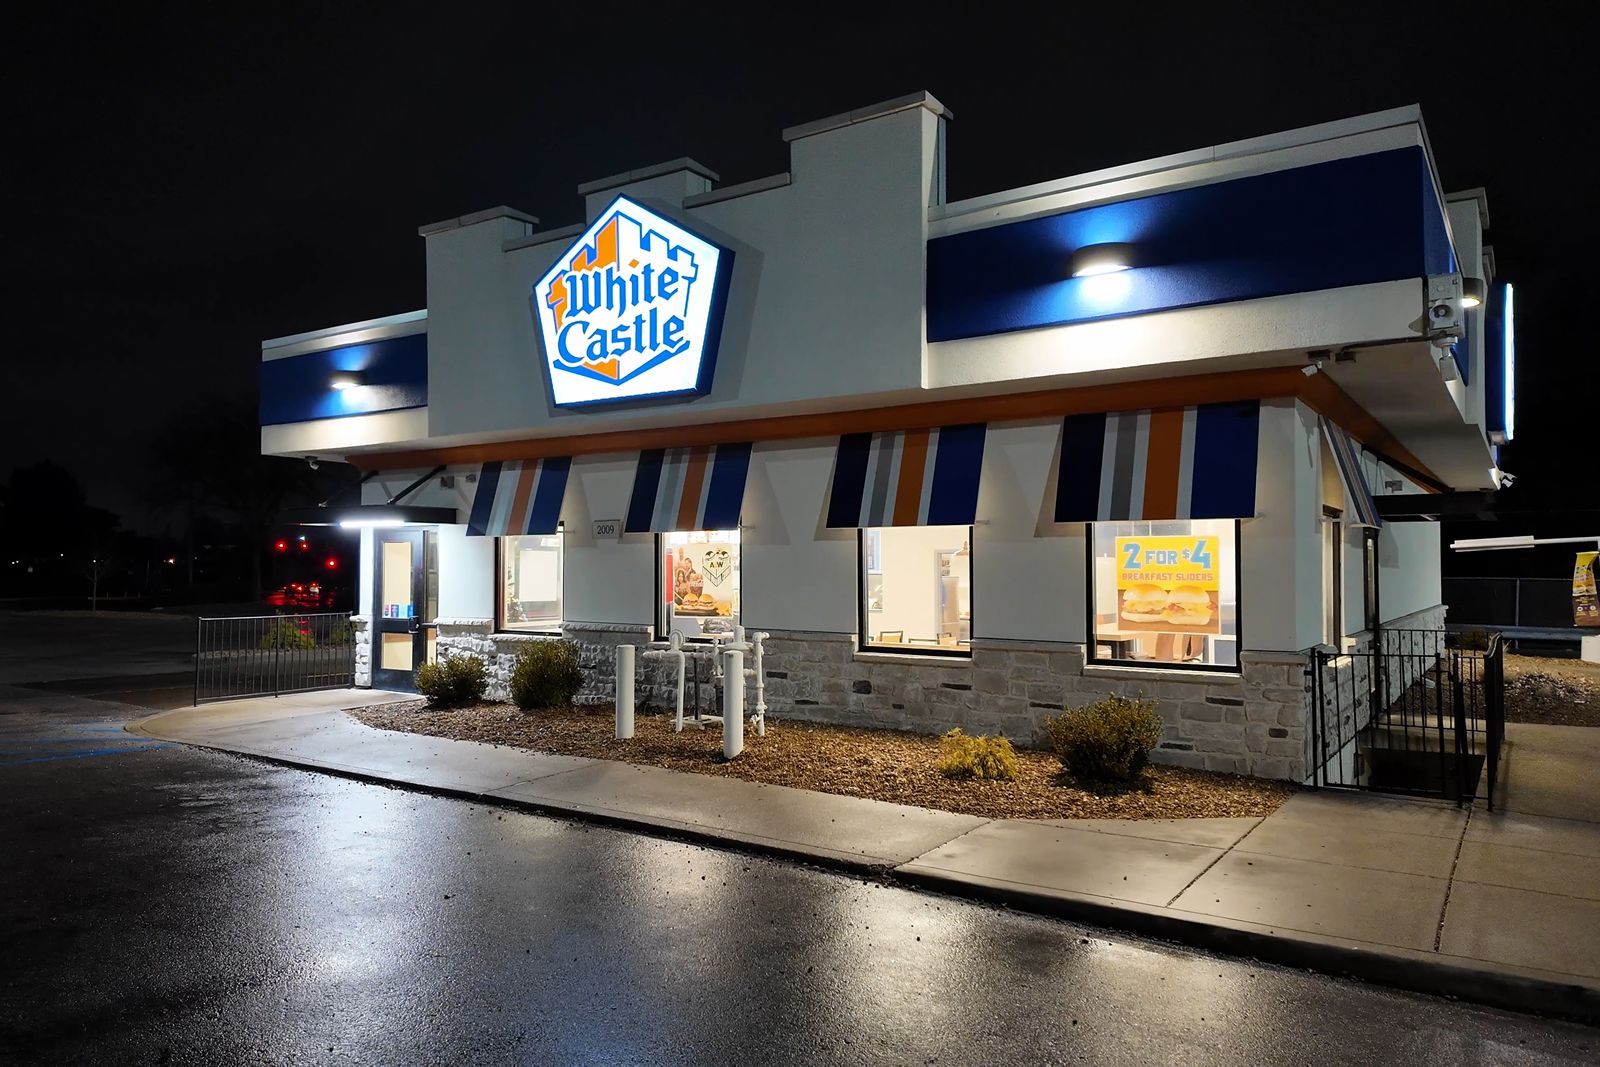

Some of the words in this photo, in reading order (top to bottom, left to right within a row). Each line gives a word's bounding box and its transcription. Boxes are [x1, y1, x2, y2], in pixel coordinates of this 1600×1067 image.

[565, 260, 679, 318] White
[557, 307, 685, 364] Castle
[597, 525, 615, 535] 2009
[1123, 543, 1142, 569] 2
[1145, 550, 1178, 565] FOR
[1181, 540, 1211, 569] $4
[1121, 572, 1173, 581] BREAKFAST
[1175, 572, 1213, 582] SLIDERS
